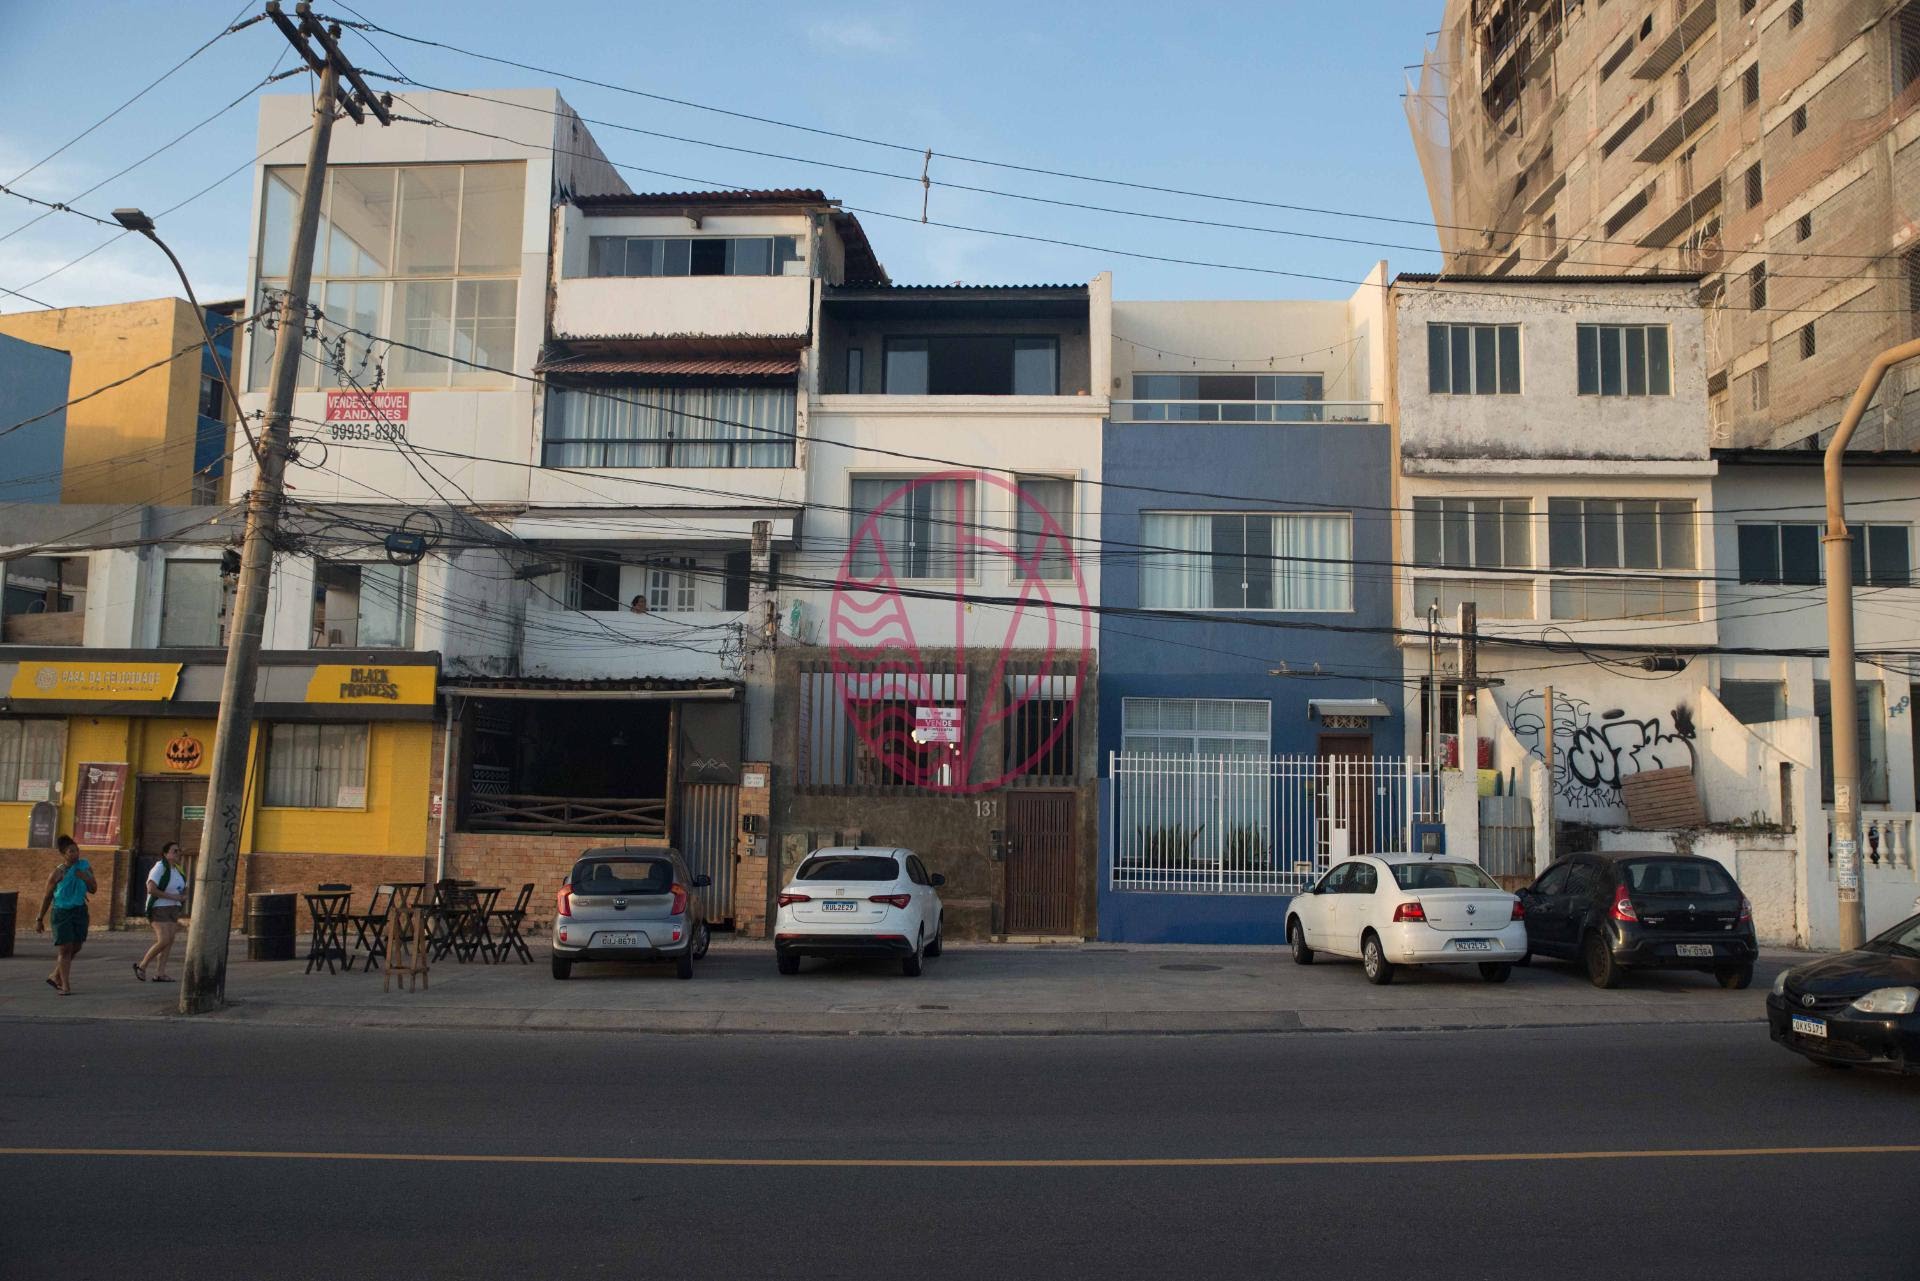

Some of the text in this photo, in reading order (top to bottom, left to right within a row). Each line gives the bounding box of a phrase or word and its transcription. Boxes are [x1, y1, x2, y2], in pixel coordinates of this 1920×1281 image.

[375, 392, 407, 409] IMÓVEL
[333, 409, 401, 420] 2 ANDARES
[1888, 696, 1910, 718] 149
[926, 719, 953, 727] VENDE
